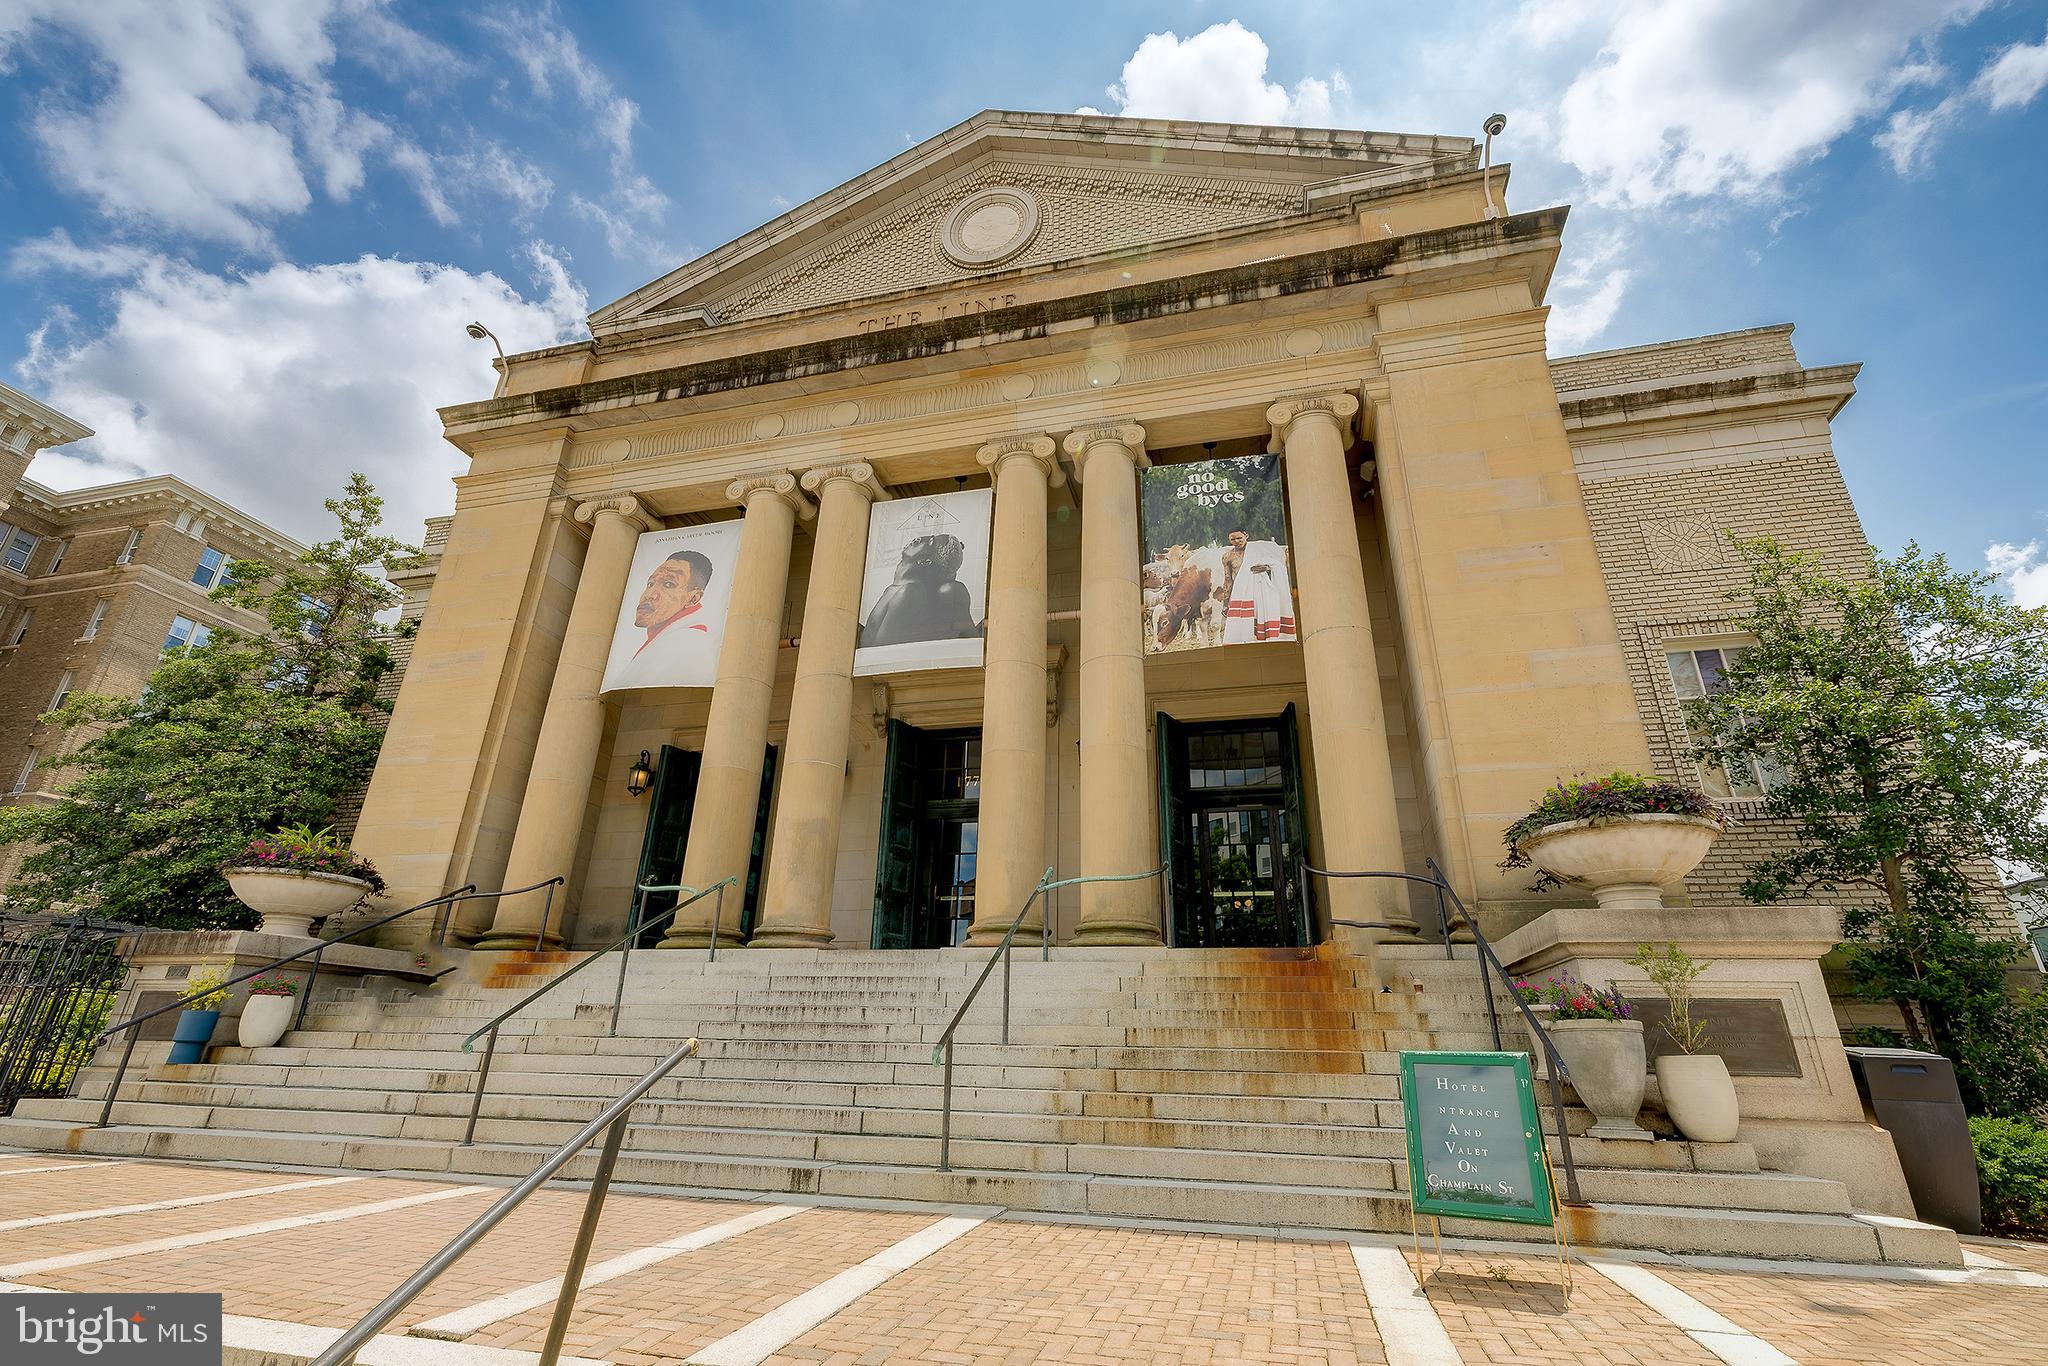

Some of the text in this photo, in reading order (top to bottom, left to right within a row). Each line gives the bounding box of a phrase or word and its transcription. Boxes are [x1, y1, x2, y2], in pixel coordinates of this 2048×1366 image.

[858, 294, 1017, 334] THE LINE
[1188, 472, 1215, 484] no
[1176, 478, 1230, 499] good
[1197, 491, 1245, 508] byes
[1436, 1077, 1486, 1092] HOTEL
[1439, 1106, 1500, 1118] NTRANCE
[1447, 1122, 1482, 1137] AND
[1444, 1140, 1489, 1157] VALET
[1458, 1160, 1478, 1173] ON
[1427, 1173, 1492, 1192] CHAMPLAIN
